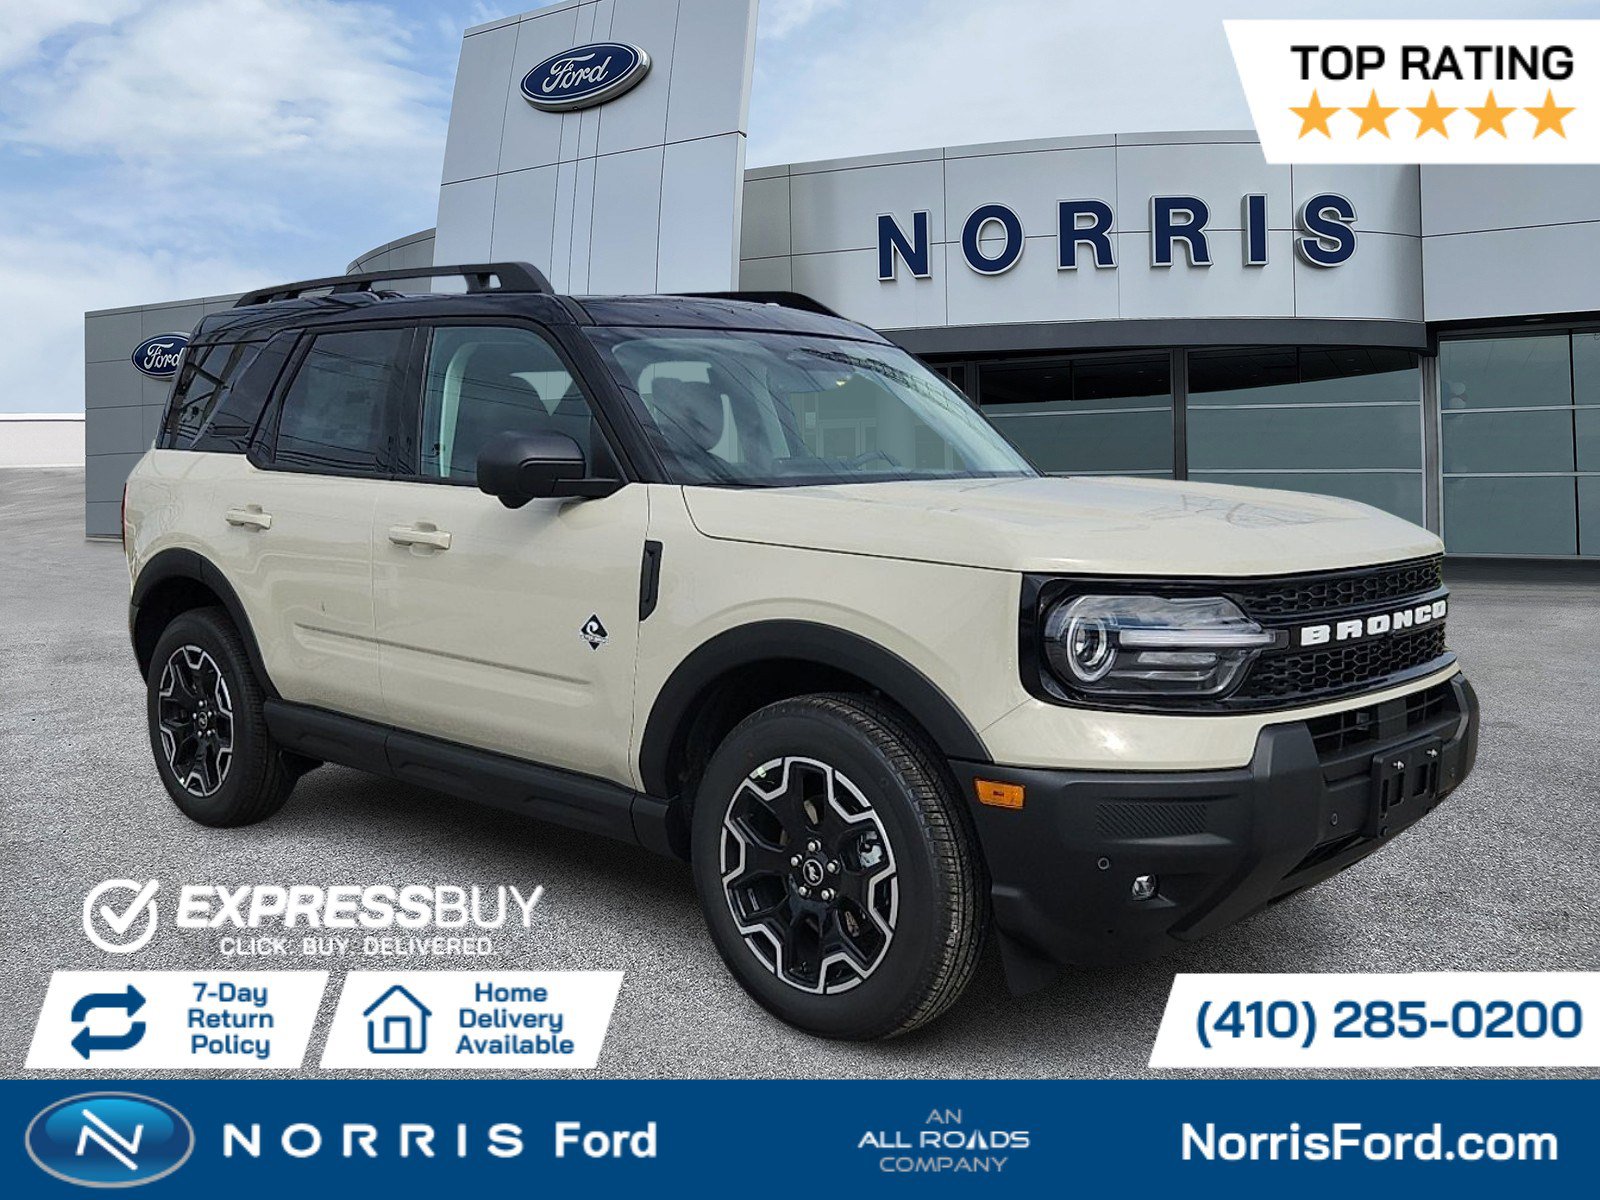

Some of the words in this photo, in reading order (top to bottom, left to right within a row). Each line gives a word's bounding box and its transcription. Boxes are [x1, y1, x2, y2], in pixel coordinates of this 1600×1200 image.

[541, 53, 612, 93] Ford
[876, 192, 1358, 281] NORRIS
[143, 342, 185, 370] Ford
[1300, 600, 1448, 646] BRONCO
